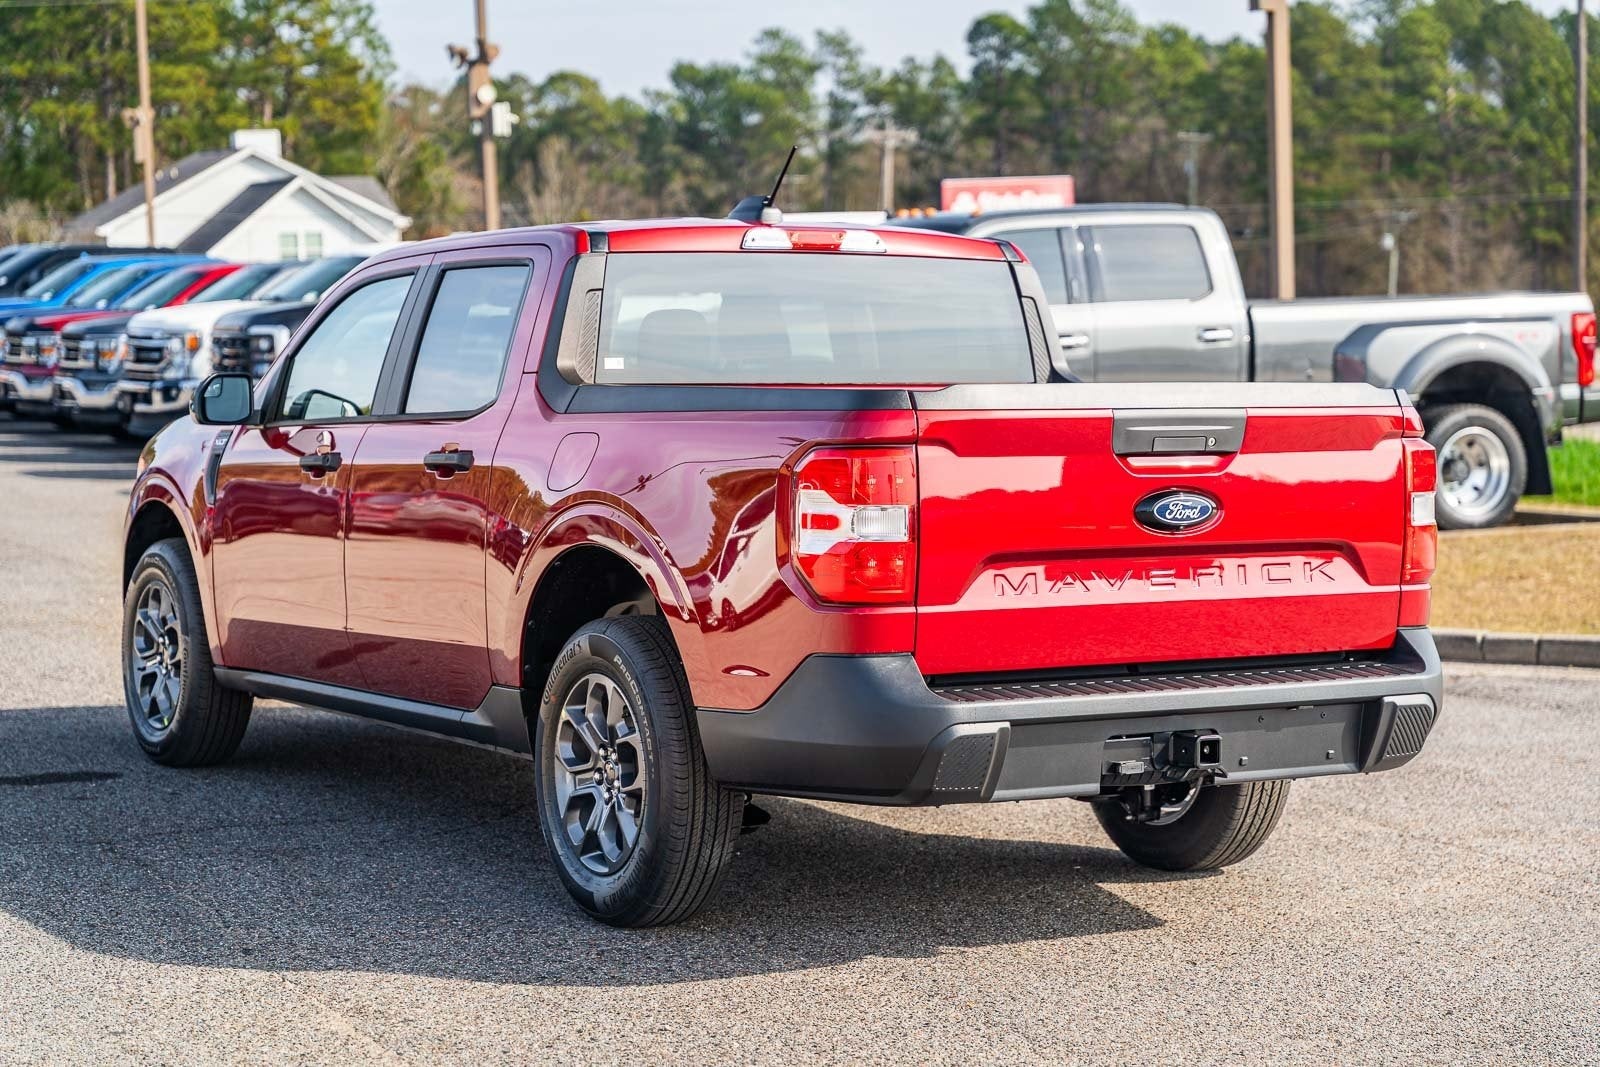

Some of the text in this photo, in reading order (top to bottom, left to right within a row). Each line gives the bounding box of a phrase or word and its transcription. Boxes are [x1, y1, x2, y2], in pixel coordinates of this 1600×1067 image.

[1165, 500, 1202, 519] Ford
[993, 560, 1336, 597] MAVERICK
[543, 642, 577, 705] Continental
